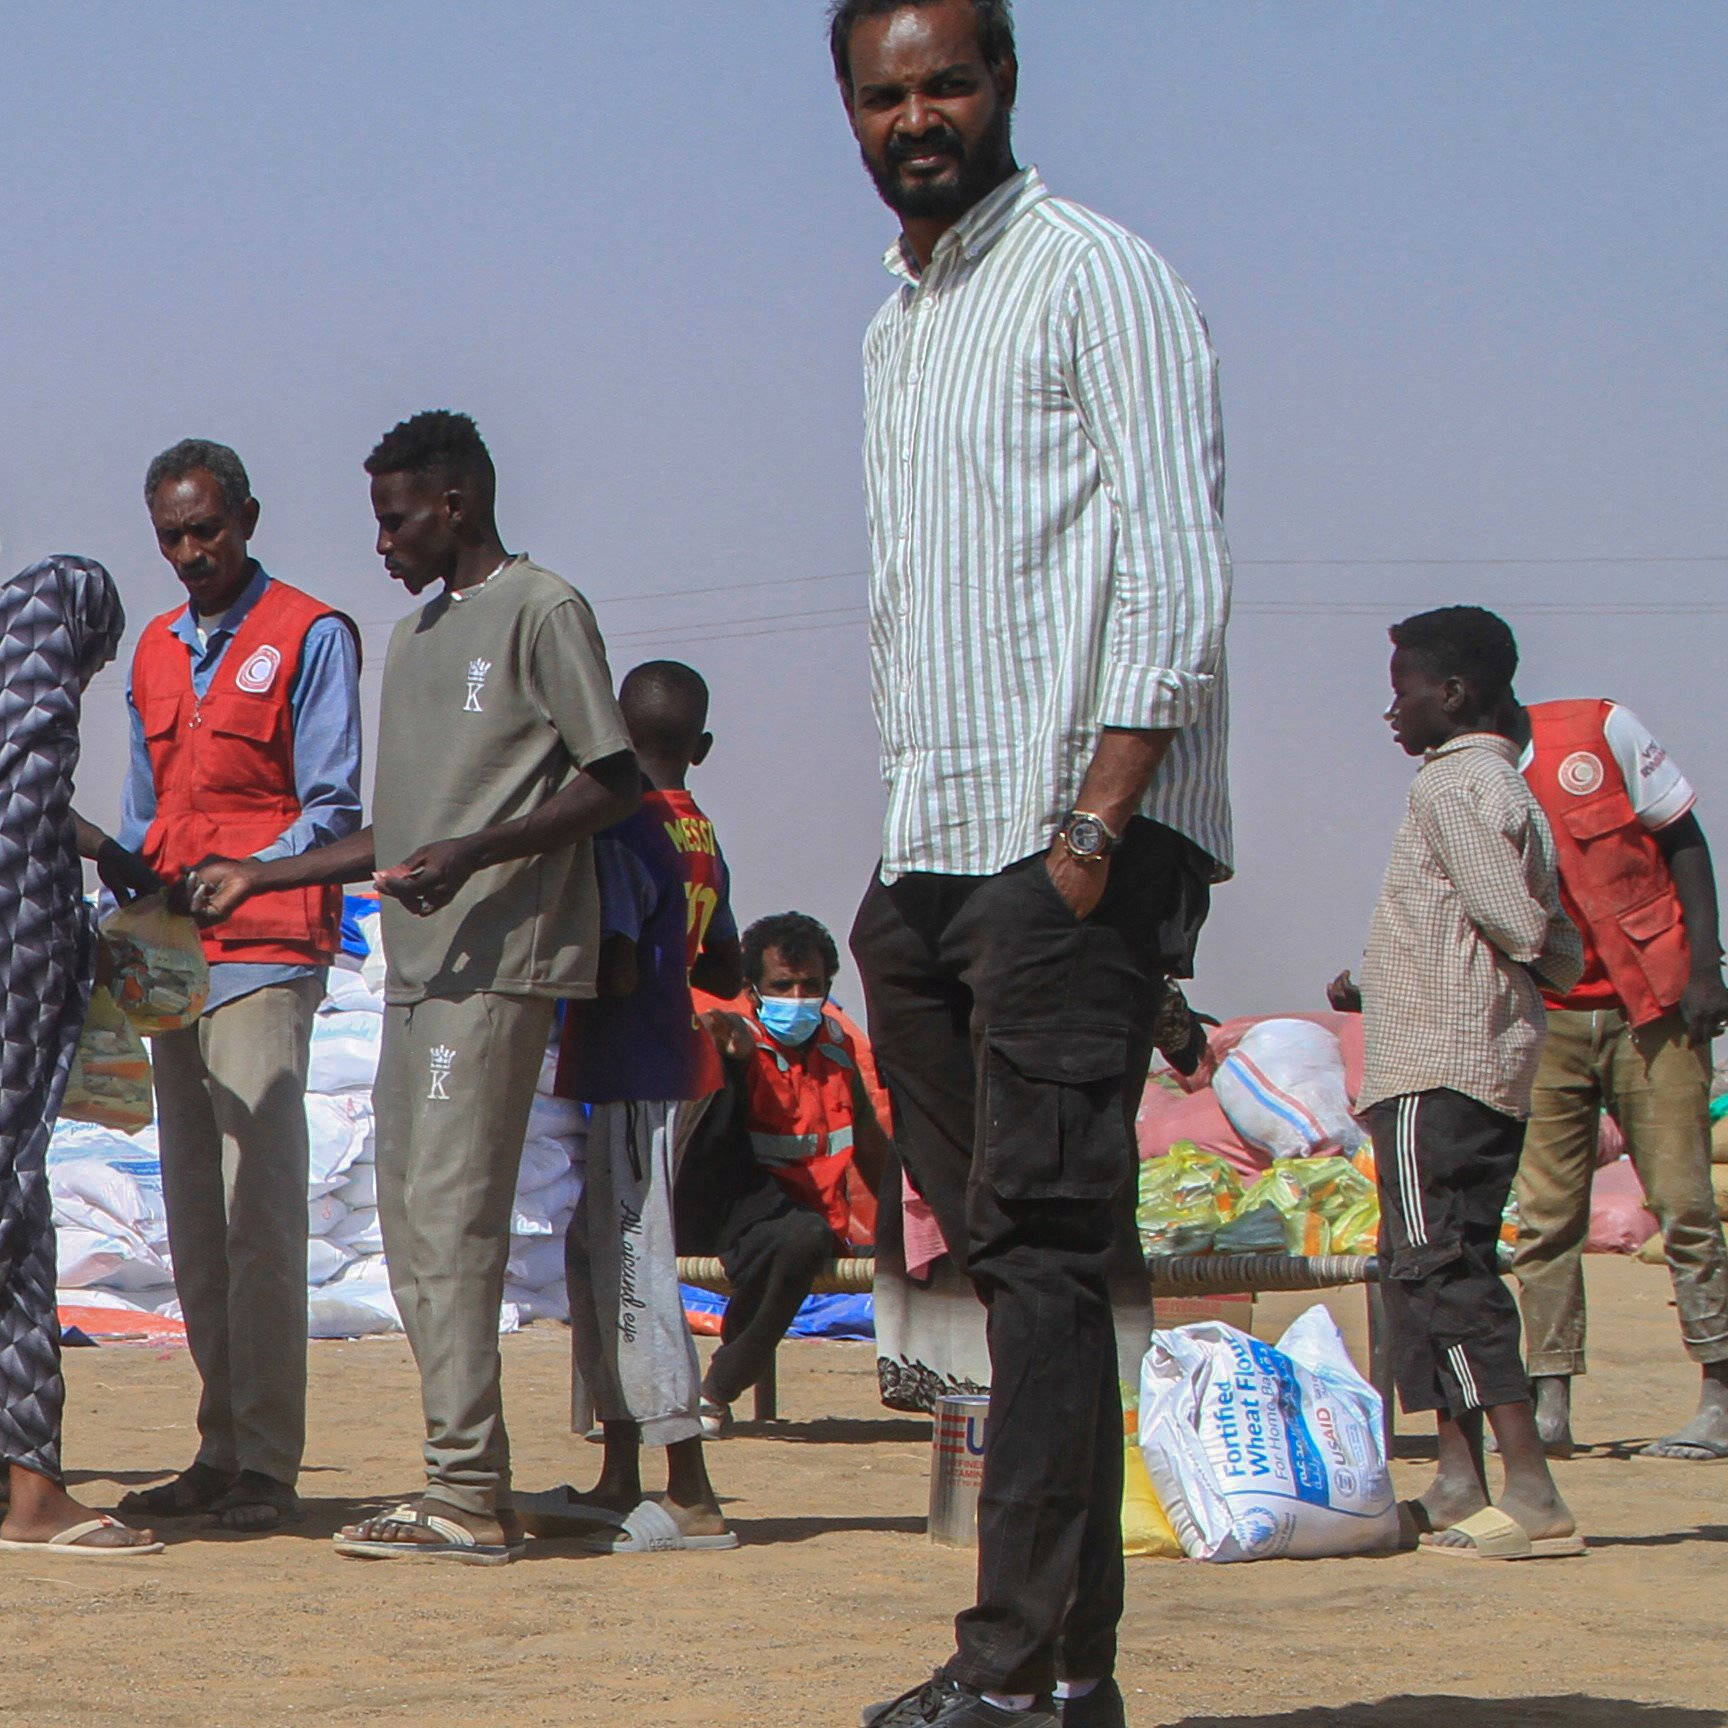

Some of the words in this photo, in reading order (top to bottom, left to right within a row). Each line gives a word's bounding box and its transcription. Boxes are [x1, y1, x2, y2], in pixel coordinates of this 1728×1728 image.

[463, 682, 484, 712] K
[664, 817, 716, 857] MESSI
[427, 1070, 450, 1100] K
[620, 1199, 643, 1236] All
[1224, 1334, 1257, 1391] Flour
[1213, 1380, 1246, 1477] Fortified
[1241, 1398, 1271, 1476] Wheat
[1265, 1399, 1282, 1450] Home
[1315, 1406, 1346, 1466] USAID
[1274, 1457, 1289, 1481] For
